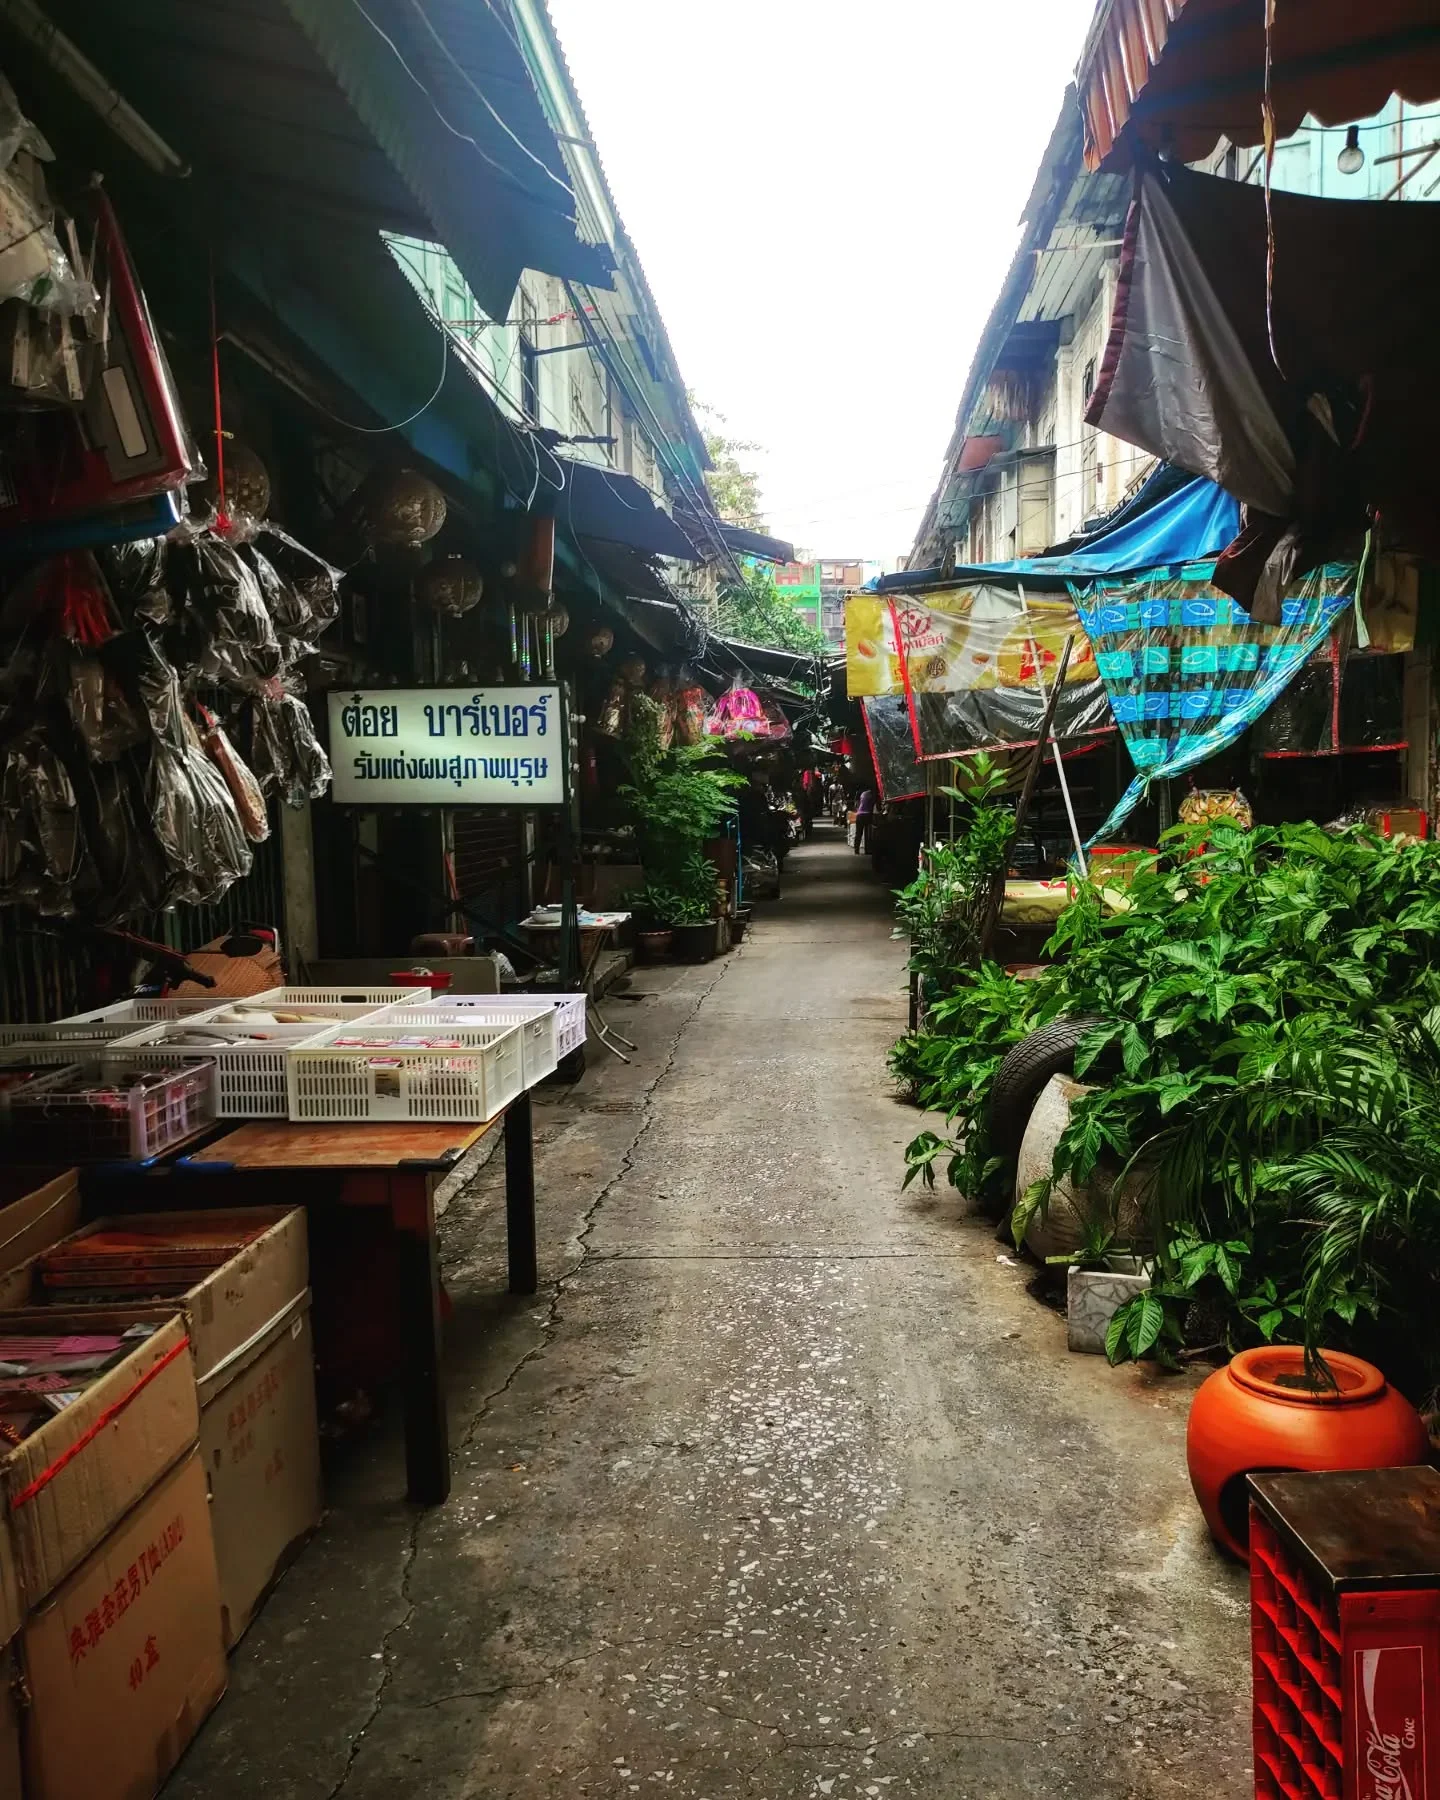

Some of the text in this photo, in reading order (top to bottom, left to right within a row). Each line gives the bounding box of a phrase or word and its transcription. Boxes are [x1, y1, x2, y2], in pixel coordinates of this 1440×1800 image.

[341, 692, 553, 738] ต๋อย บาร์เบอร์
[353, 750, 549, 788] รับแต่งผมสุภาพบุรุษ
[1402, 1717, 1416, 1749] Coke
